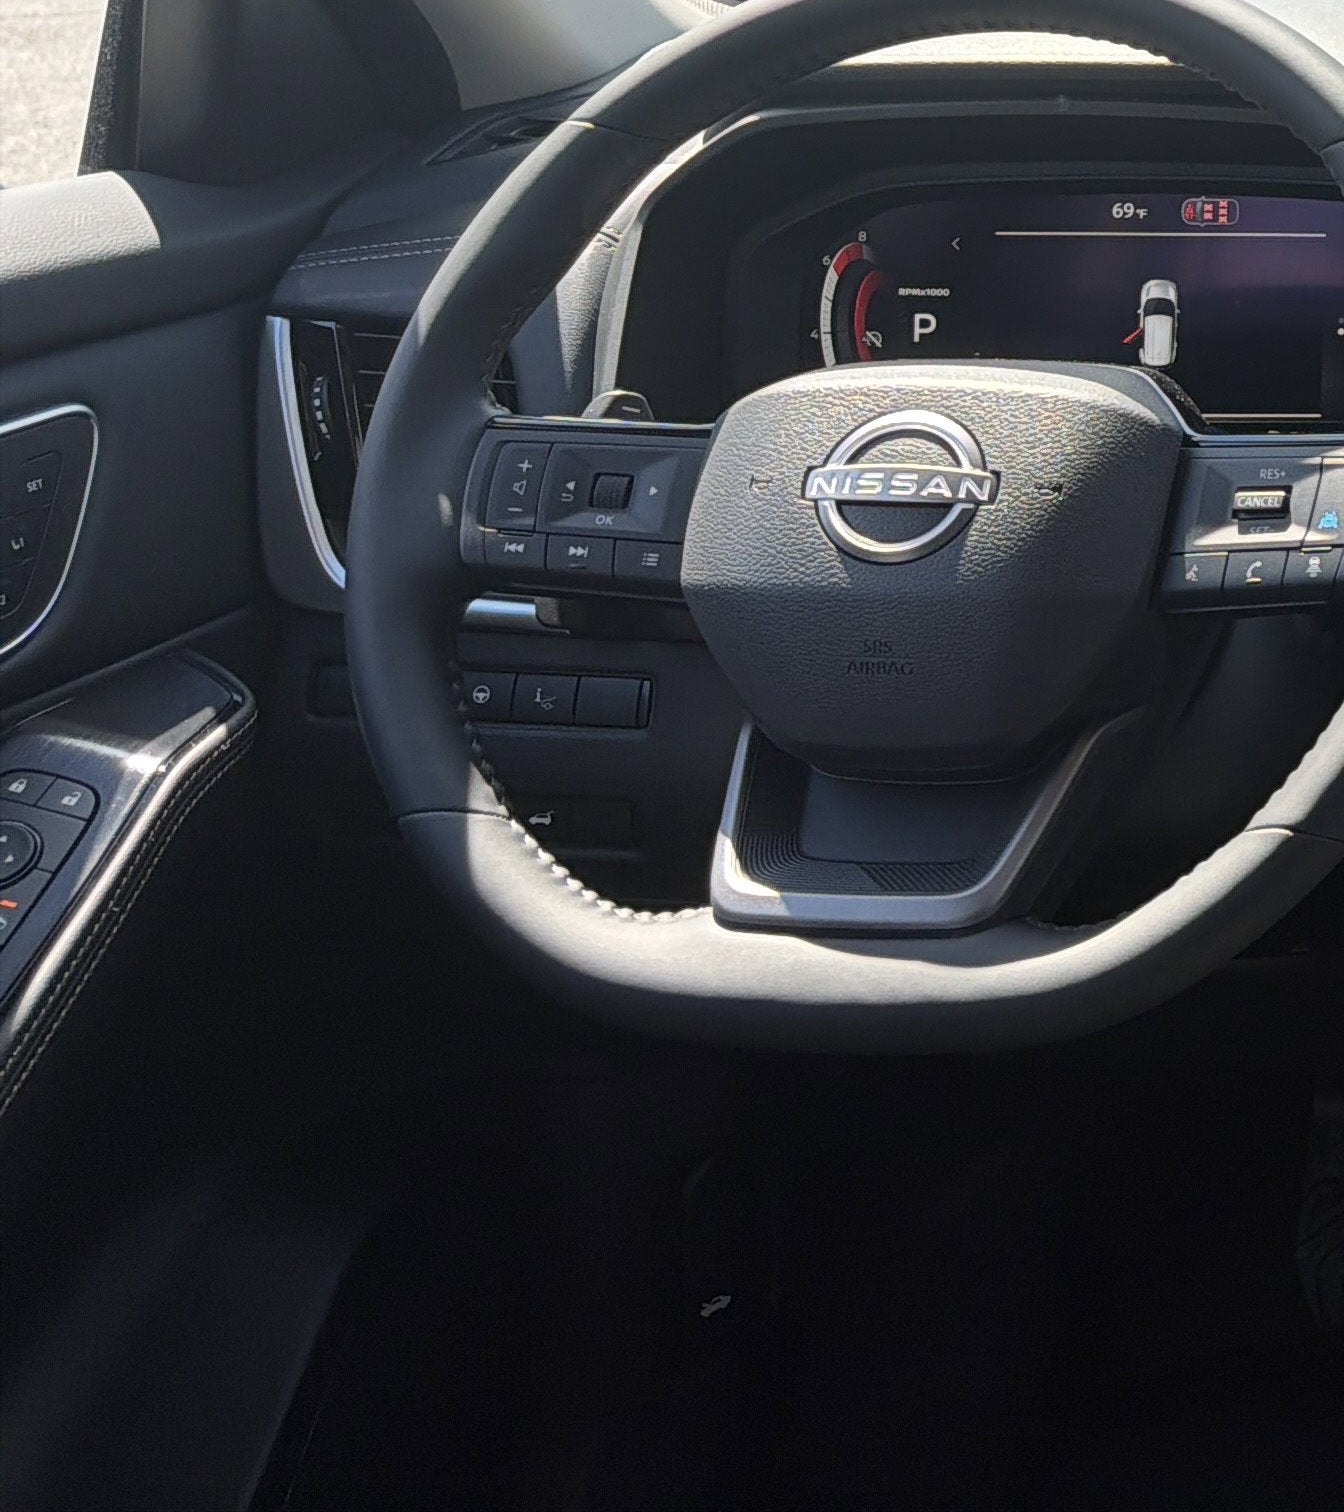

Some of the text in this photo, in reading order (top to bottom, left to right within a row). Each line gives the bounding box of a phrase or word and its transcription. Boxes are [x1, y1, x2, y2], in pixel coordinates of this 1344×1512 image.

[858, 231, 867, 242] 8
[822, 255, 831, 265] 6
[913, 313, 937, 342] P
[810, 329, 819, 339] 4
[1260, 469, 1286, 480] RES+
[26, 478, 43, 493] SET
[809, 473, 991, 501] NISSAN
[1237, 496, 1280, 508] CANCEL
[595, 515, 615, 525] OK
[863, 639, 892, 654] SRS
[847, 661, 913, 675] AIRBAG
